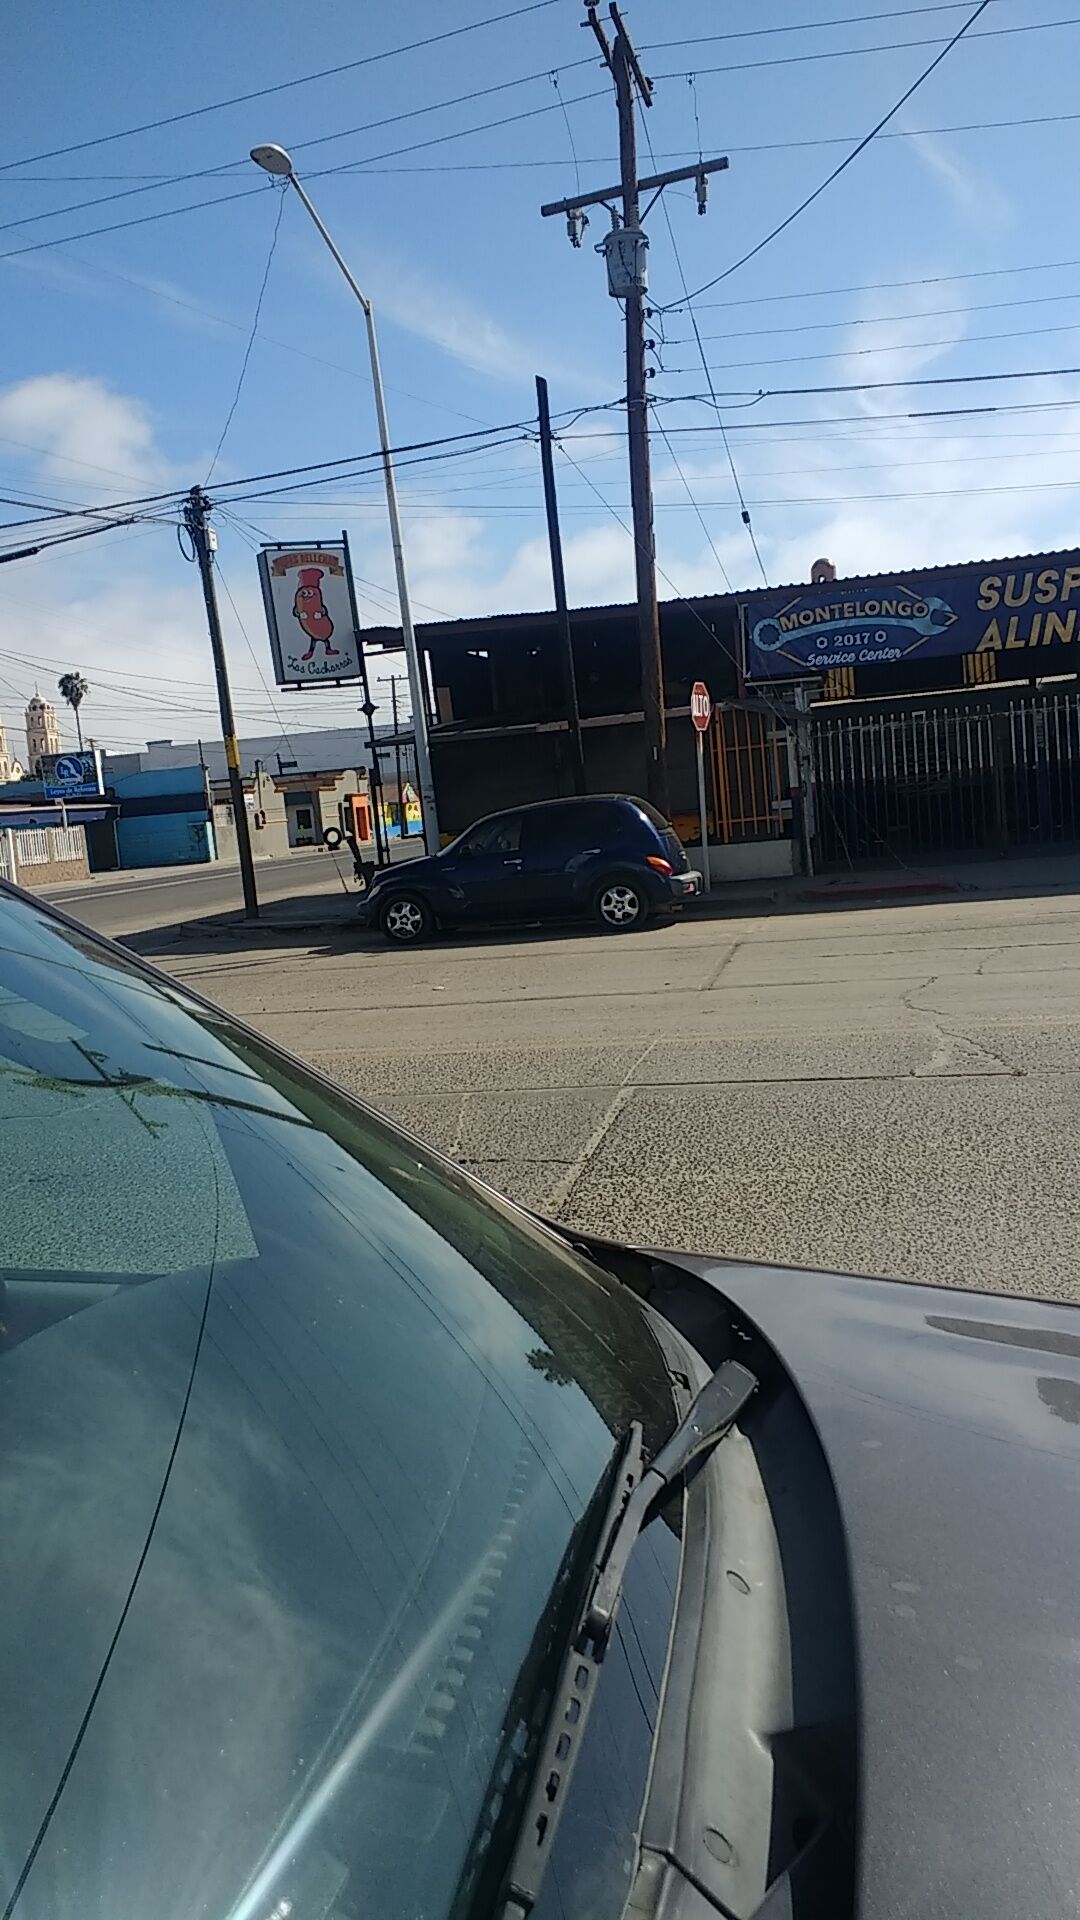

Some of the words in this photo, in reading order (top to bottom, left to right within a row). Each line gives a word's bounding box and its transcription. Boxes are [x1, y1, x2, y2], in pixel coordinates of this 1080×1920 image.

[779, 600, 928, 631] MONTELONGO
[833, 633, 871, 647] 2017
[975, 610, 1080, 653] ALIN
[806, 651, 856, 667] Service
[858, 647, 903, 662] Center
[692, 692, 709, 717] ALTO
